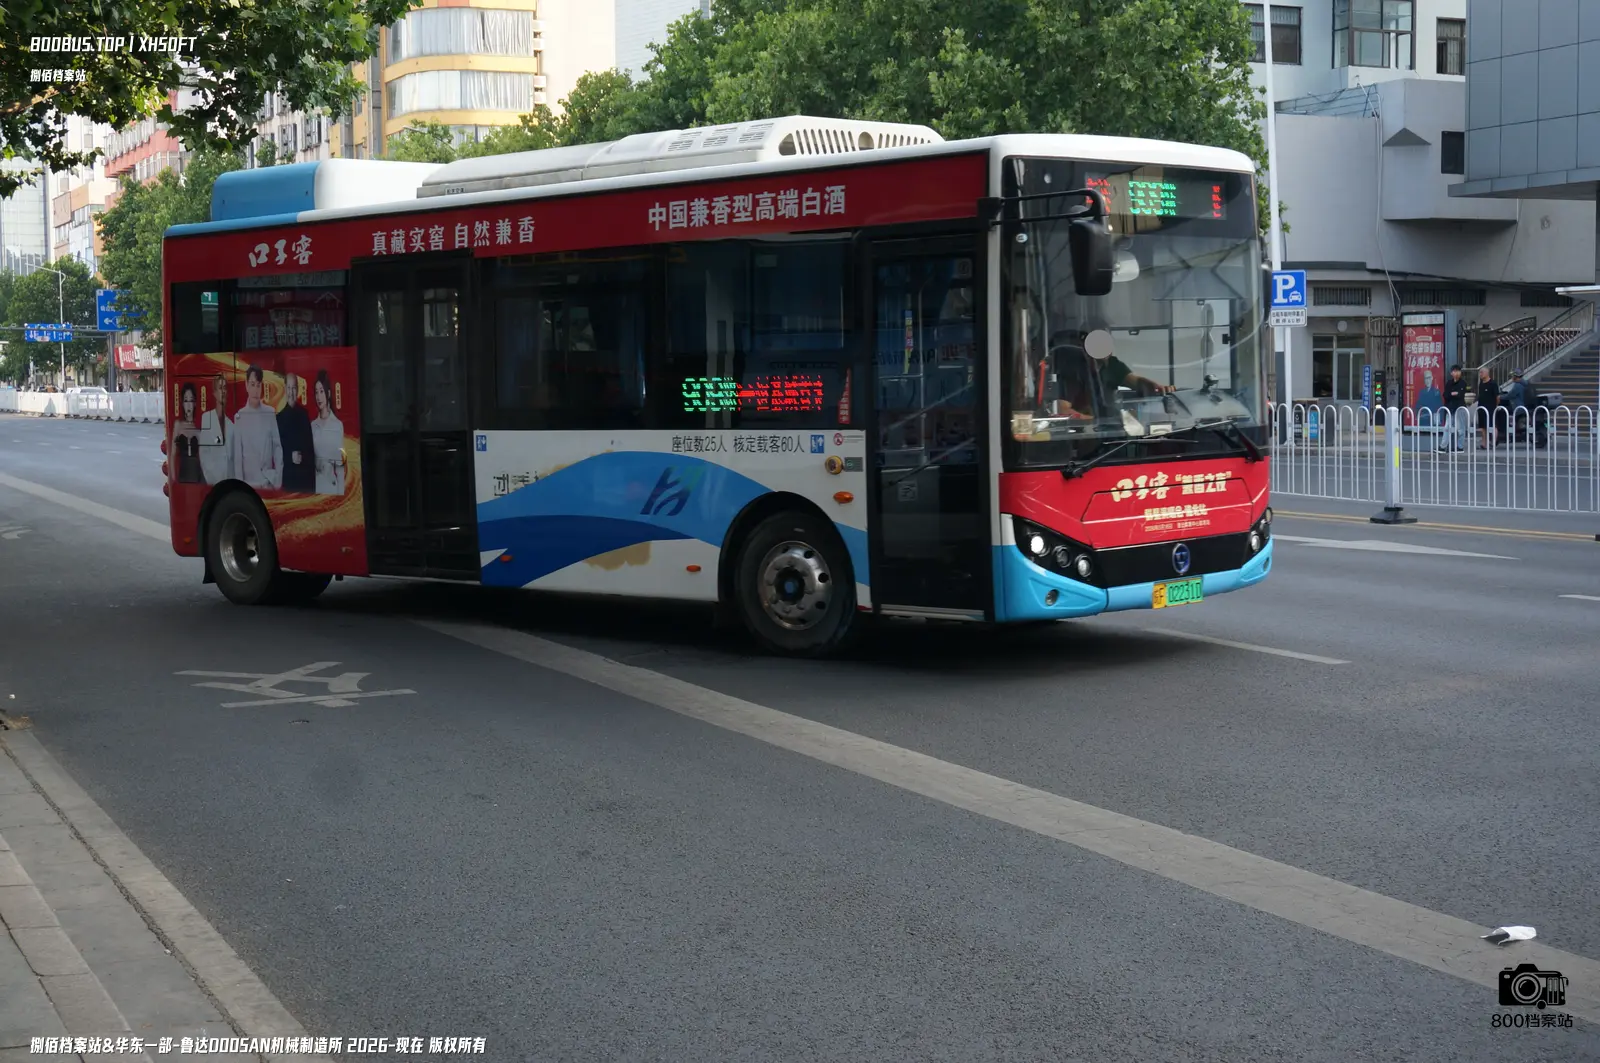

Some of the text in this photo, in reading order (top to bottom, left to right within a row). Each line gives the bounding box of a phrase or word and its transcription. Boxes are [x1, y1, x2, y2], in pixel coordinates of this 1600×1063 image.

[648, 185, 847, 231] 中国兼香型高端白酒
[371, 216, 536, 256] 真藏实窖 自然兼香
[1273, 275, 1295, 303] P
[671, 435, 806, 454] 座位数25人 核定载客60人
